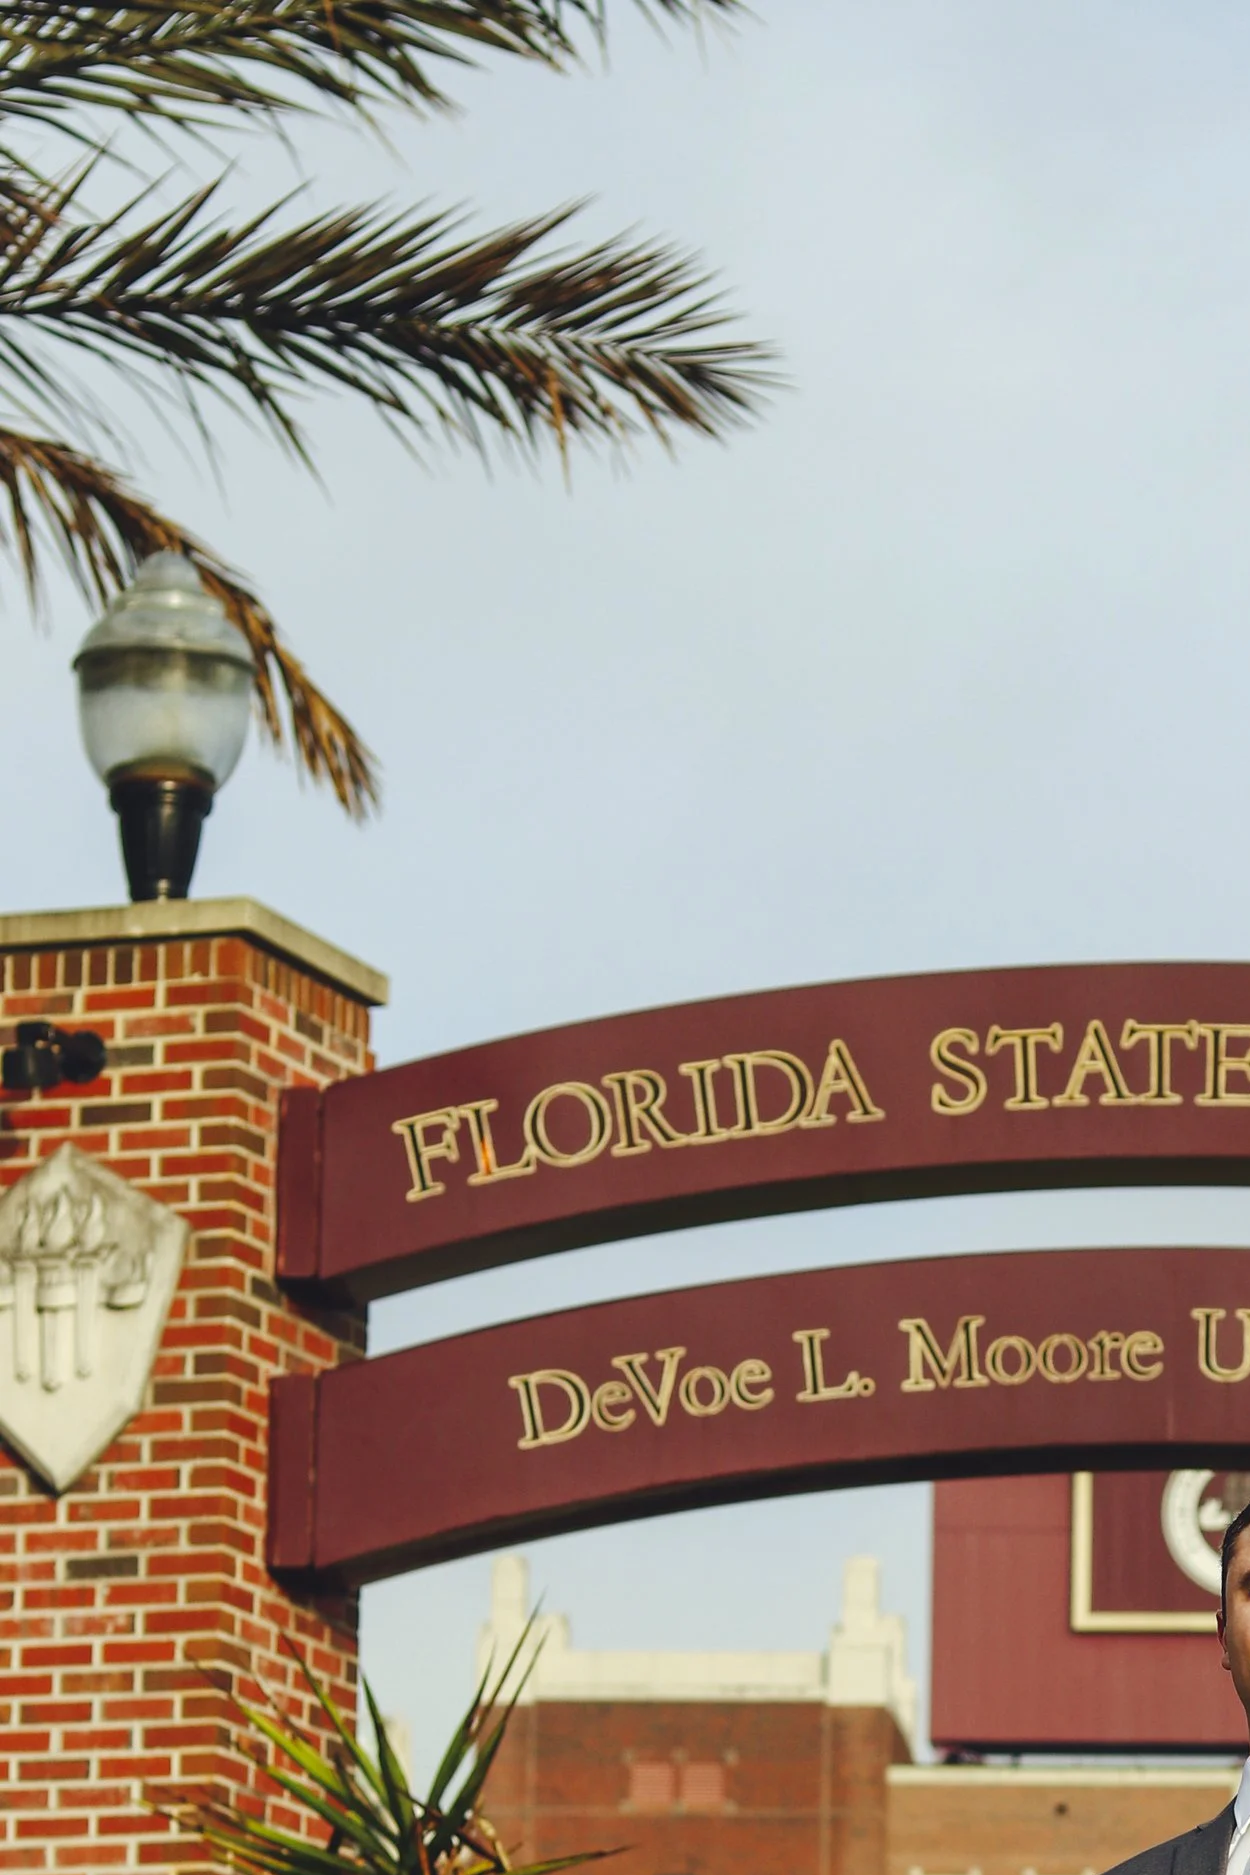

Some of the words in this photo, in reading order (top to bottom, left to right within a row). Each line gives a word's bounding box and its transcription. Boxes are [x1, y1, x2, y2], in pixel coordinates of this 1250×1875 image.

[392, 1038, 885, 1202] FLORIDA
[509, 1345, 774, 1449] DeVoe
[793, 1327, 876, 1402] L.
[898, 1314, 1165, 1392] Moore
